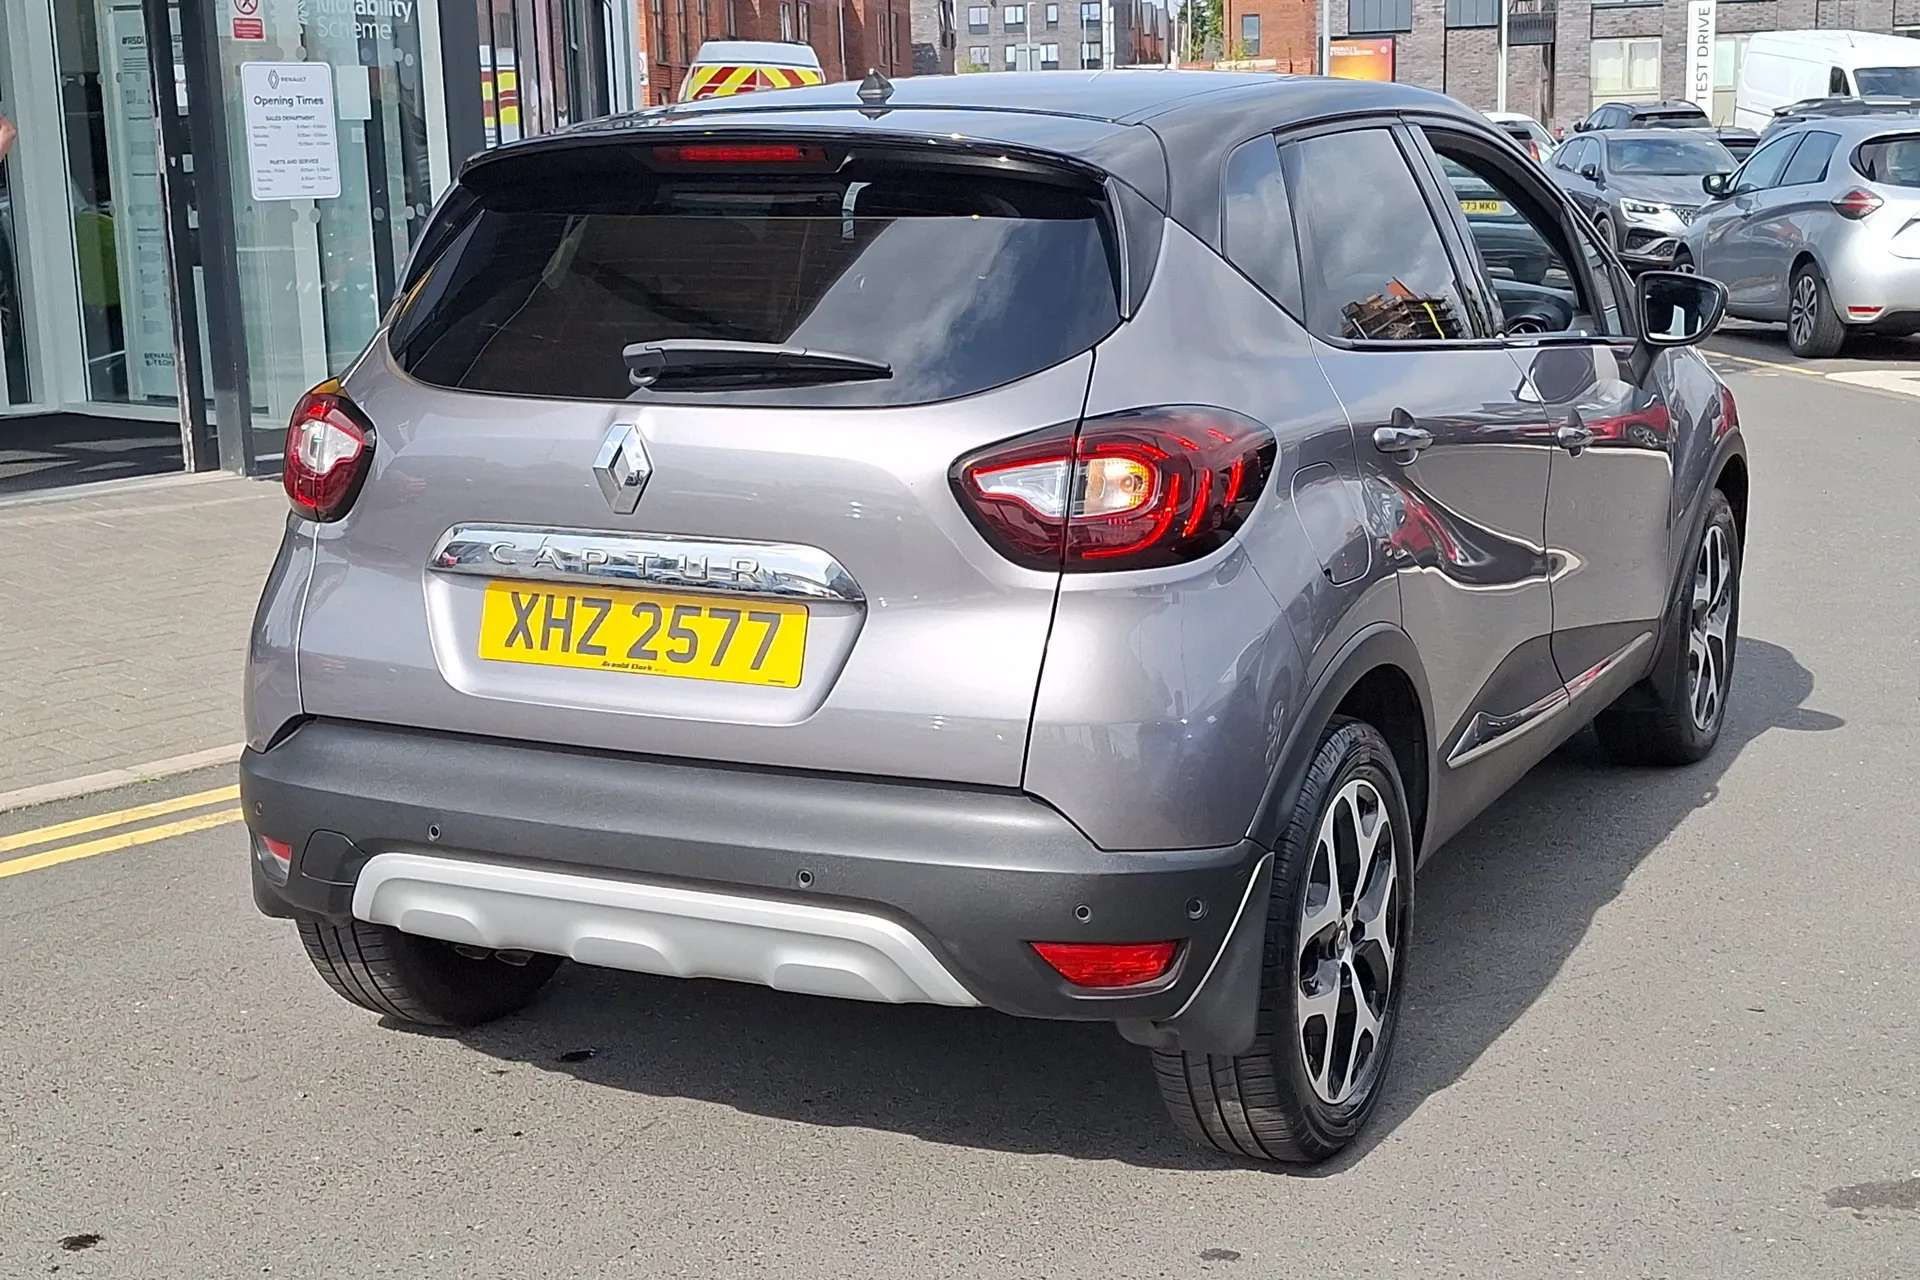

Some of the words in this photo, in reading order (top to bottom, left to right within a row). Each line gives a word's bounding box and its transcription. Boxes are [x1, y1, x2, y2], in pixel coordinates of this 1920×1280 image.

[318, 15, 393, 40] Scheme
[1697, 7, 1710, 57] DRIVE
[253, 95, 294, 107] Opening
[296, 95, 324, 105] Times
[1696, 61, 1708, 102] TEST
[488, 541, 763, 585] CAPTUR
[505, 592, 613, 657] XHZ
[627, 601, 781, 670] 2577
